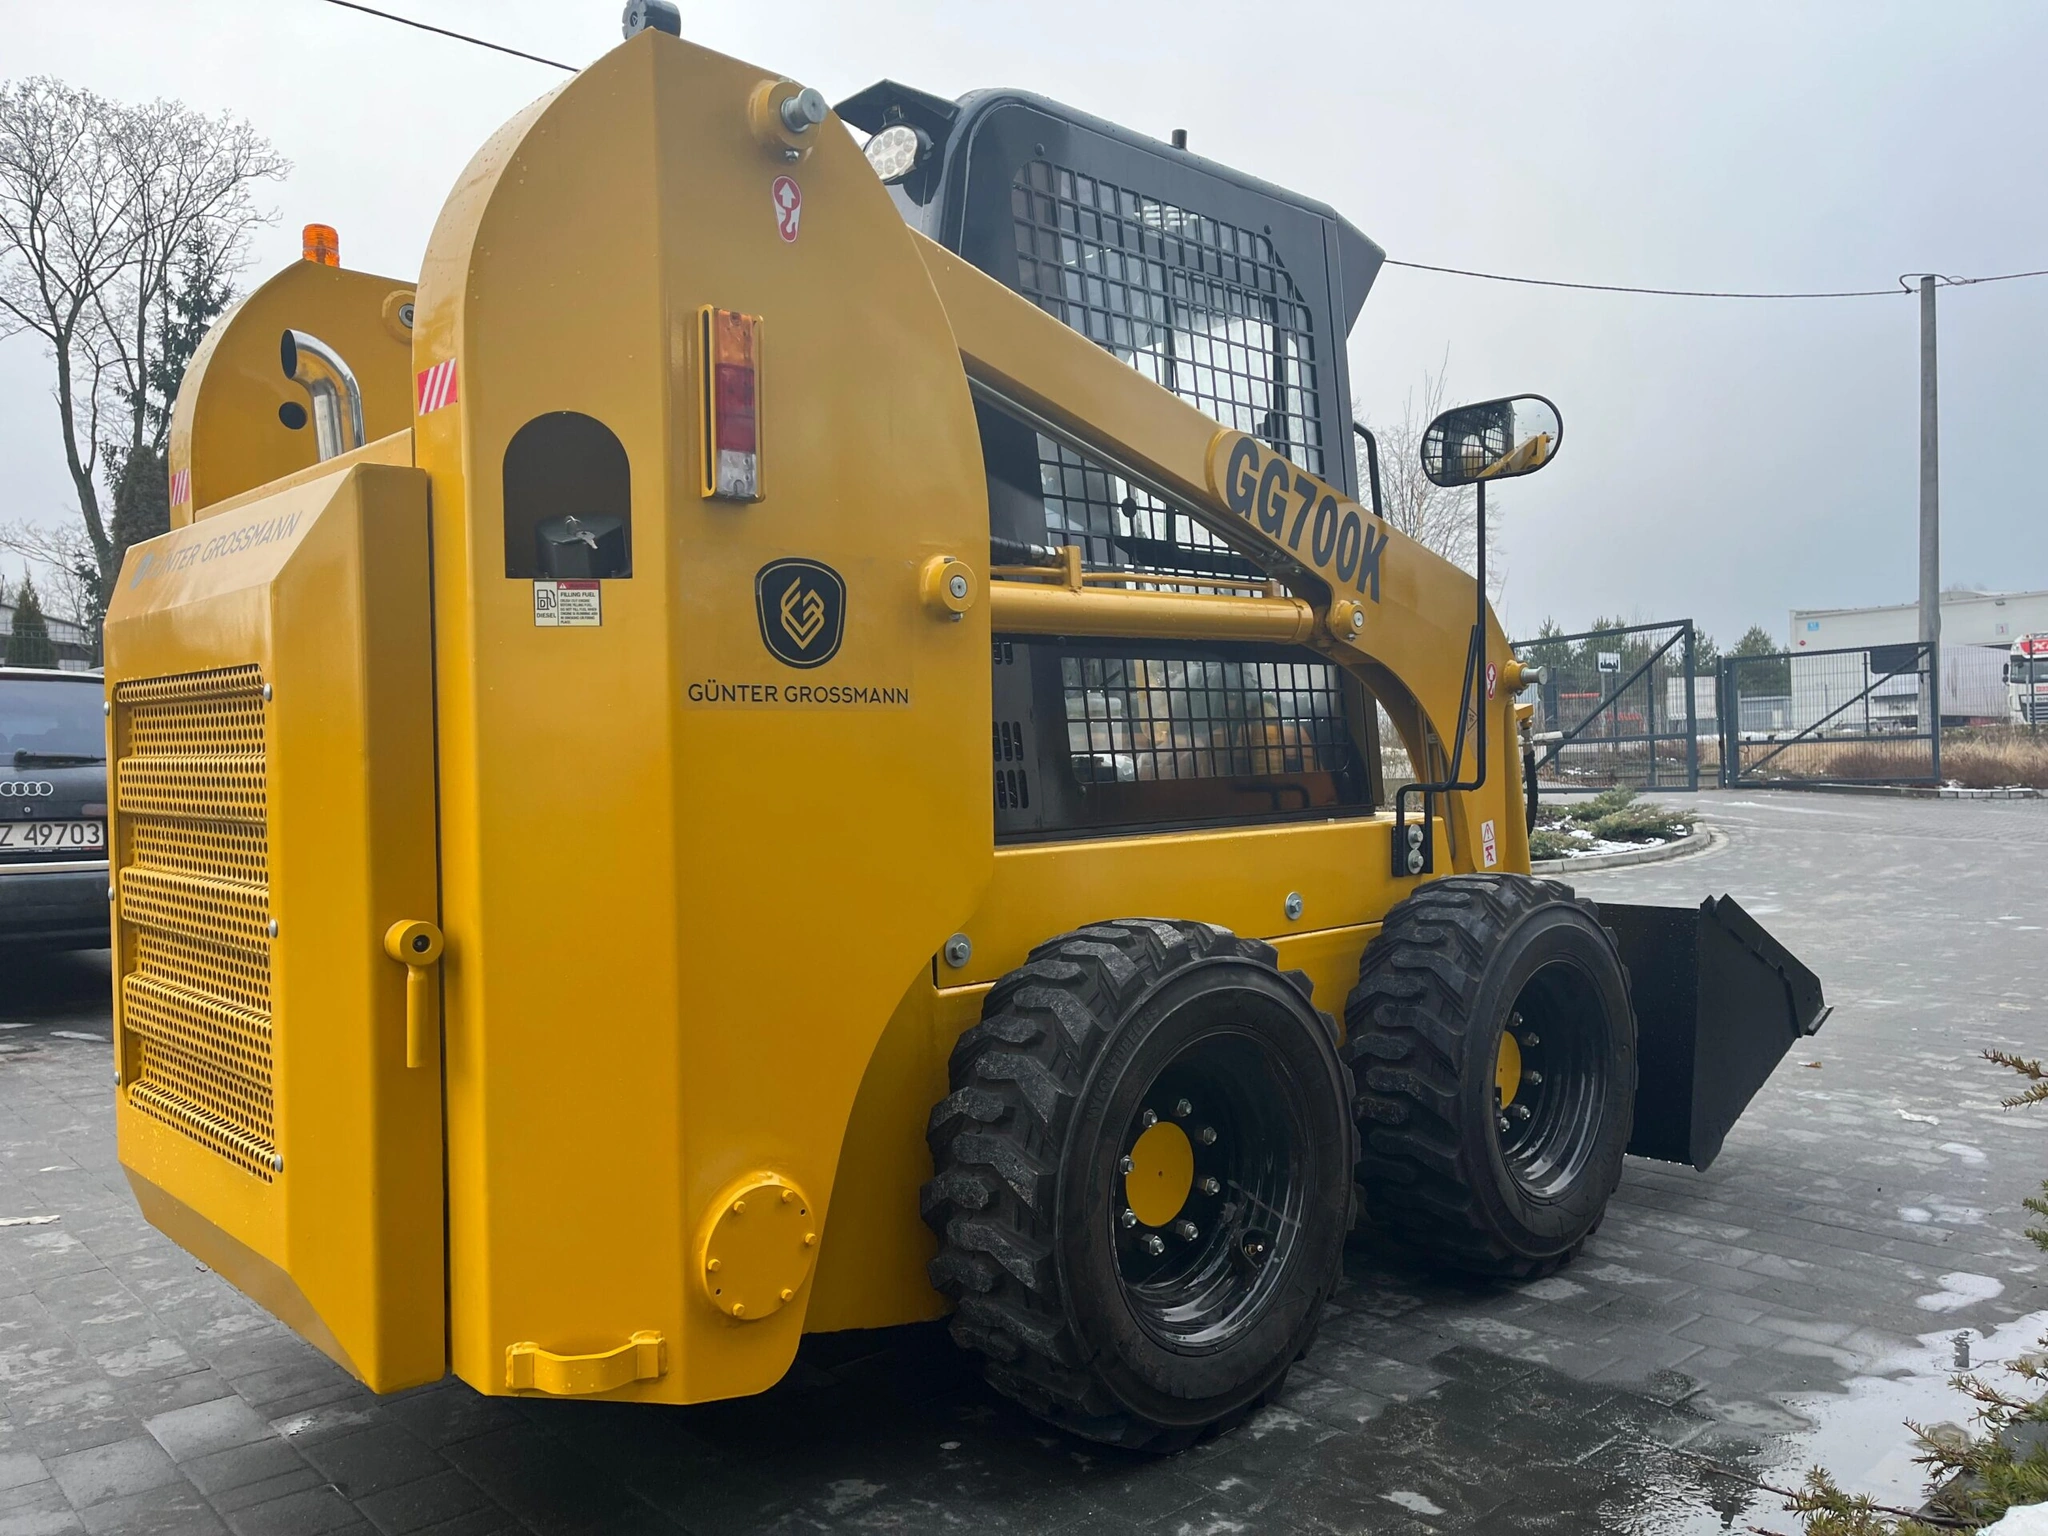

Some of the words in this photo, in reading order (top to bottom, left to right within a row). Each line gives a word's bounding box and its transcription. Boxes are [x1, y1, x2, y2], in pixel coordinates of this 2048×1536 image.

[1226, 436, 1389, 604] GG700K
[153, 543, 201, 577] NTER
[201, 511, 303, 563] GROSSMANN
[688, 679, 778, 703] GÜNTER
[784, 686, 909, 704] GROSSMANN
[23, 822, 100, 846] 49703
